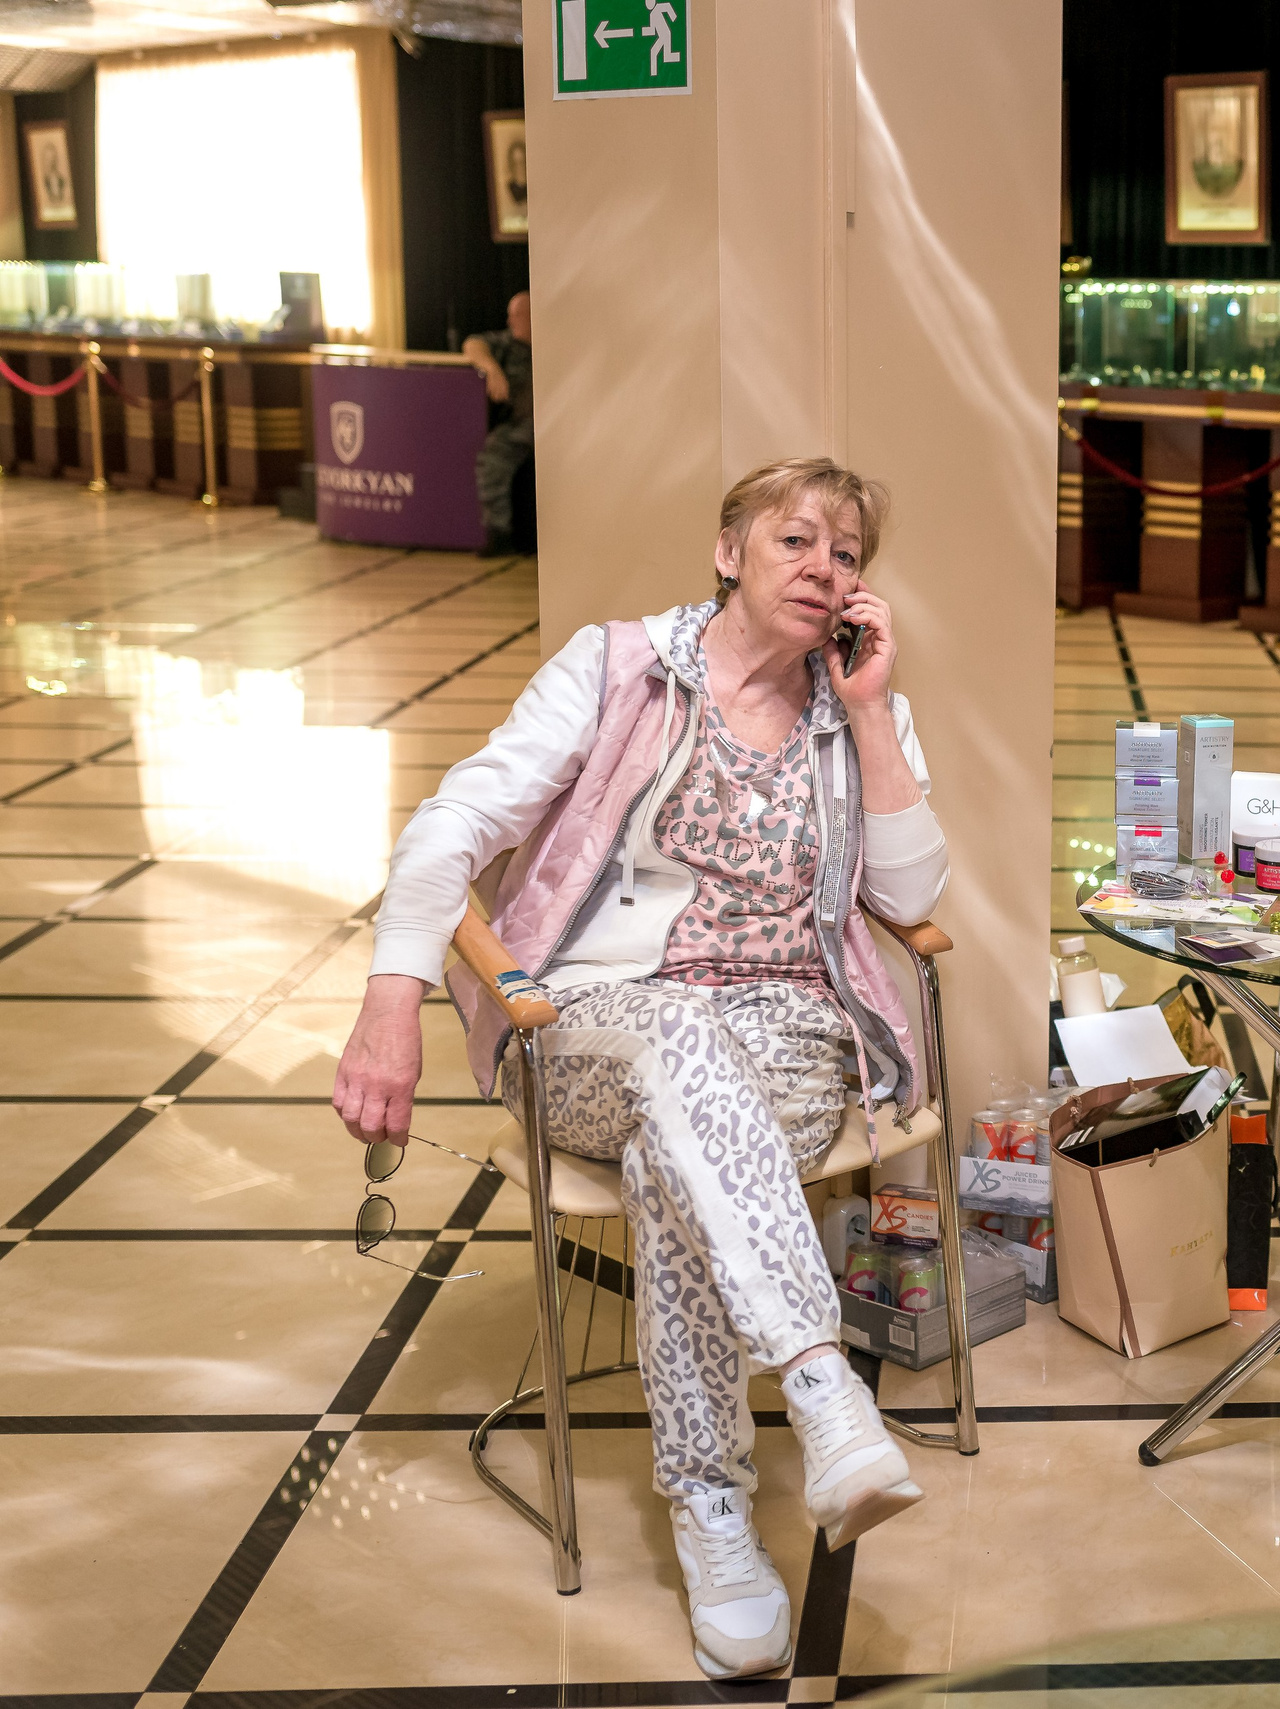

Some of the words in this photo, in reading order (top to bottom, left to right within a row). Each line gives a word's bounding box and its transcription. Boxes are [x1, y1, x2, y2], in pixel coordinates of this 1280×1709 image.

[971, 1160, 1002, 1193] XS
[1002, 1175, 1027, 1183] POWER
[1014, 1171, 1038, 1179] JUICED
[872, 1195, 908, 1232] XS
[906, 1212, 934, 1221] CANDIES
